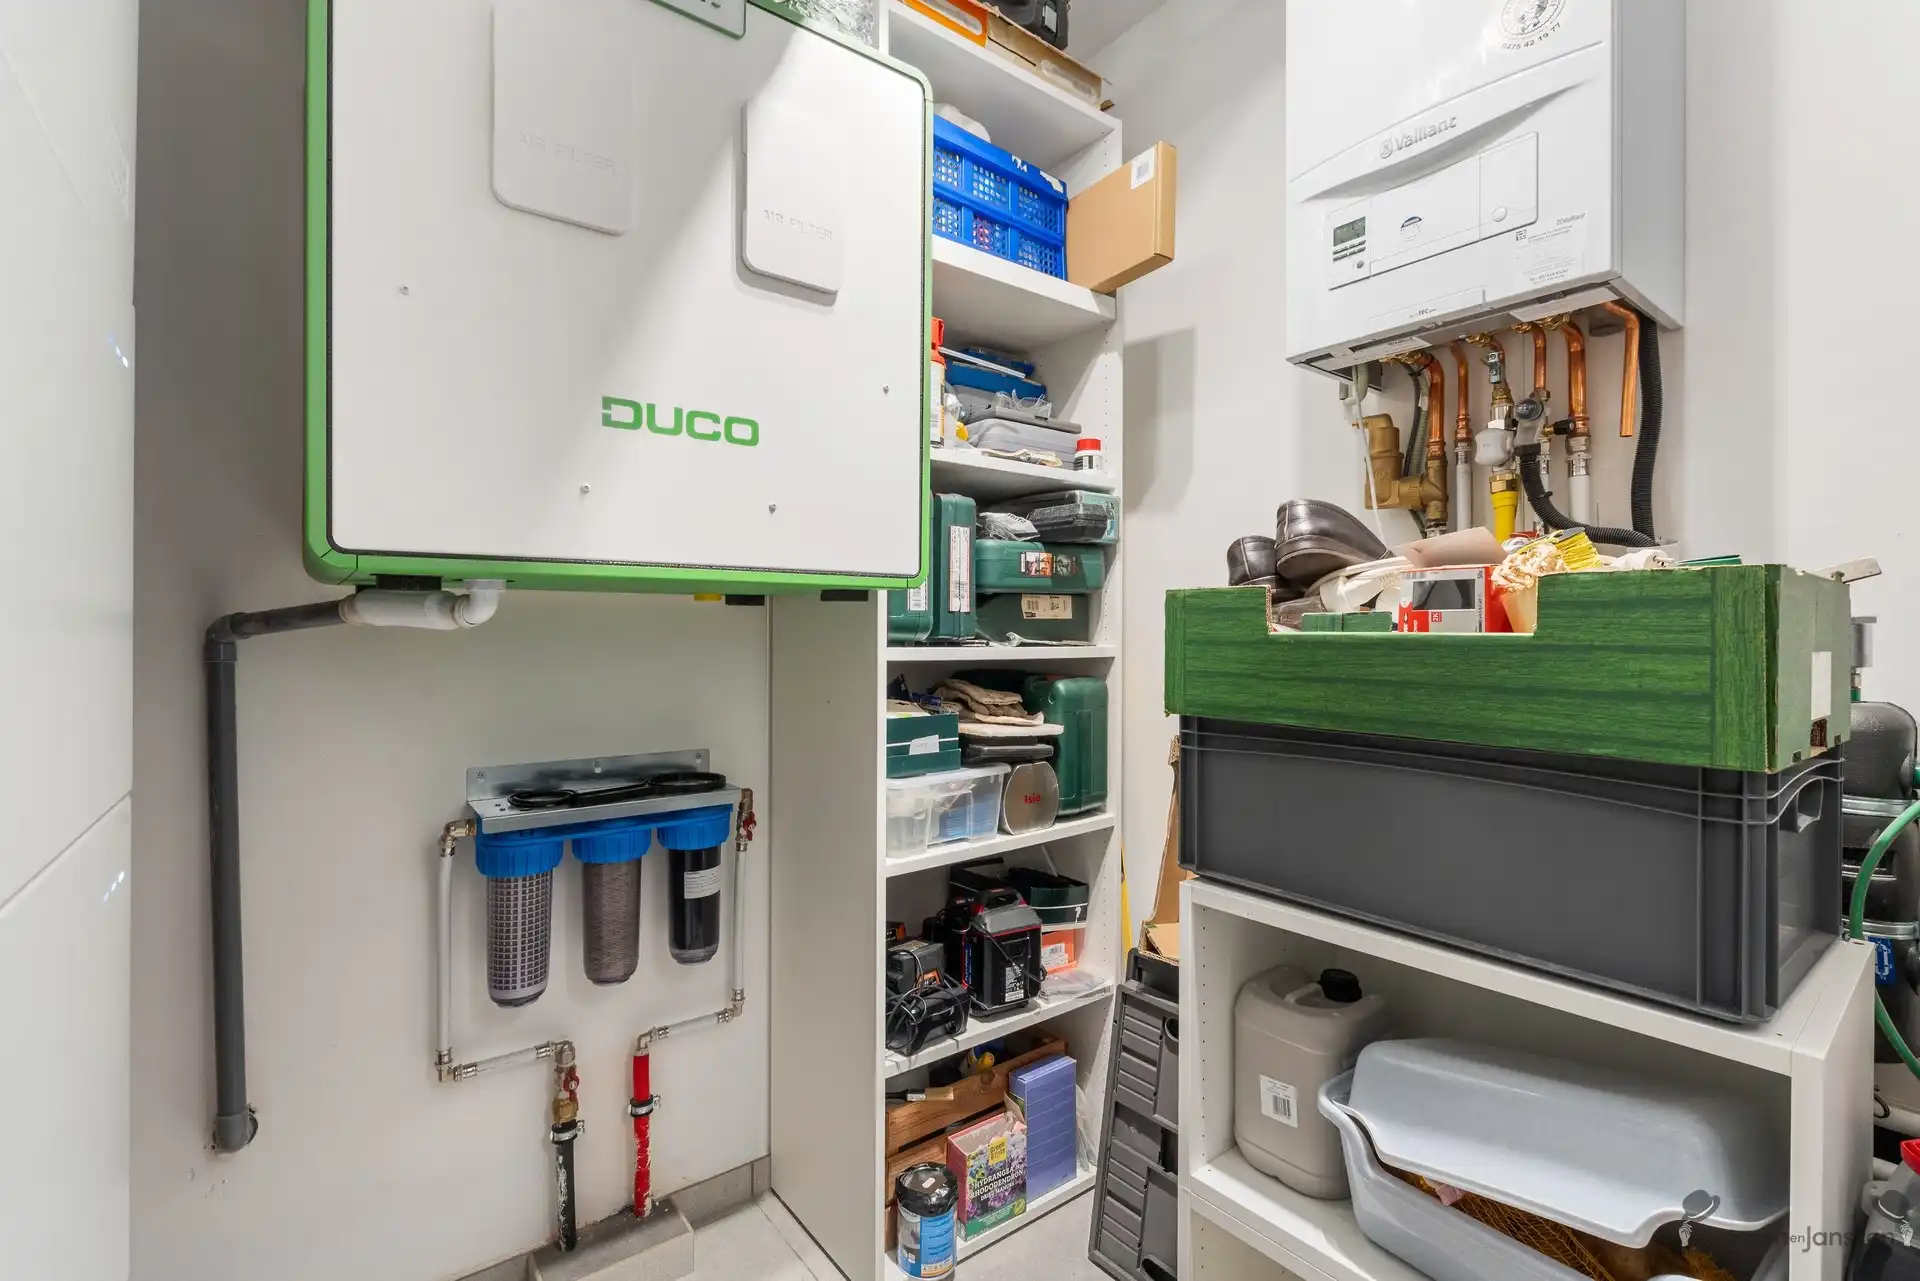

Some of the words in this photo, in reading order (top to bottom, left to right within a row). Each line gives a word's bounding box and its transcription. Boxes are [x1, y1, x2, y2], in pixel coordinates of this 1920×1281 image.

[518, 131, 546, 153] AIR
[555, 142, 616, 173] FILTER
[1393, 116, 1457, 151] Vaillant
[763, 208, 784, 228] AIR
[789, 219, 833, 243] FILTER
[601, 395, 760, 447] DUCO
